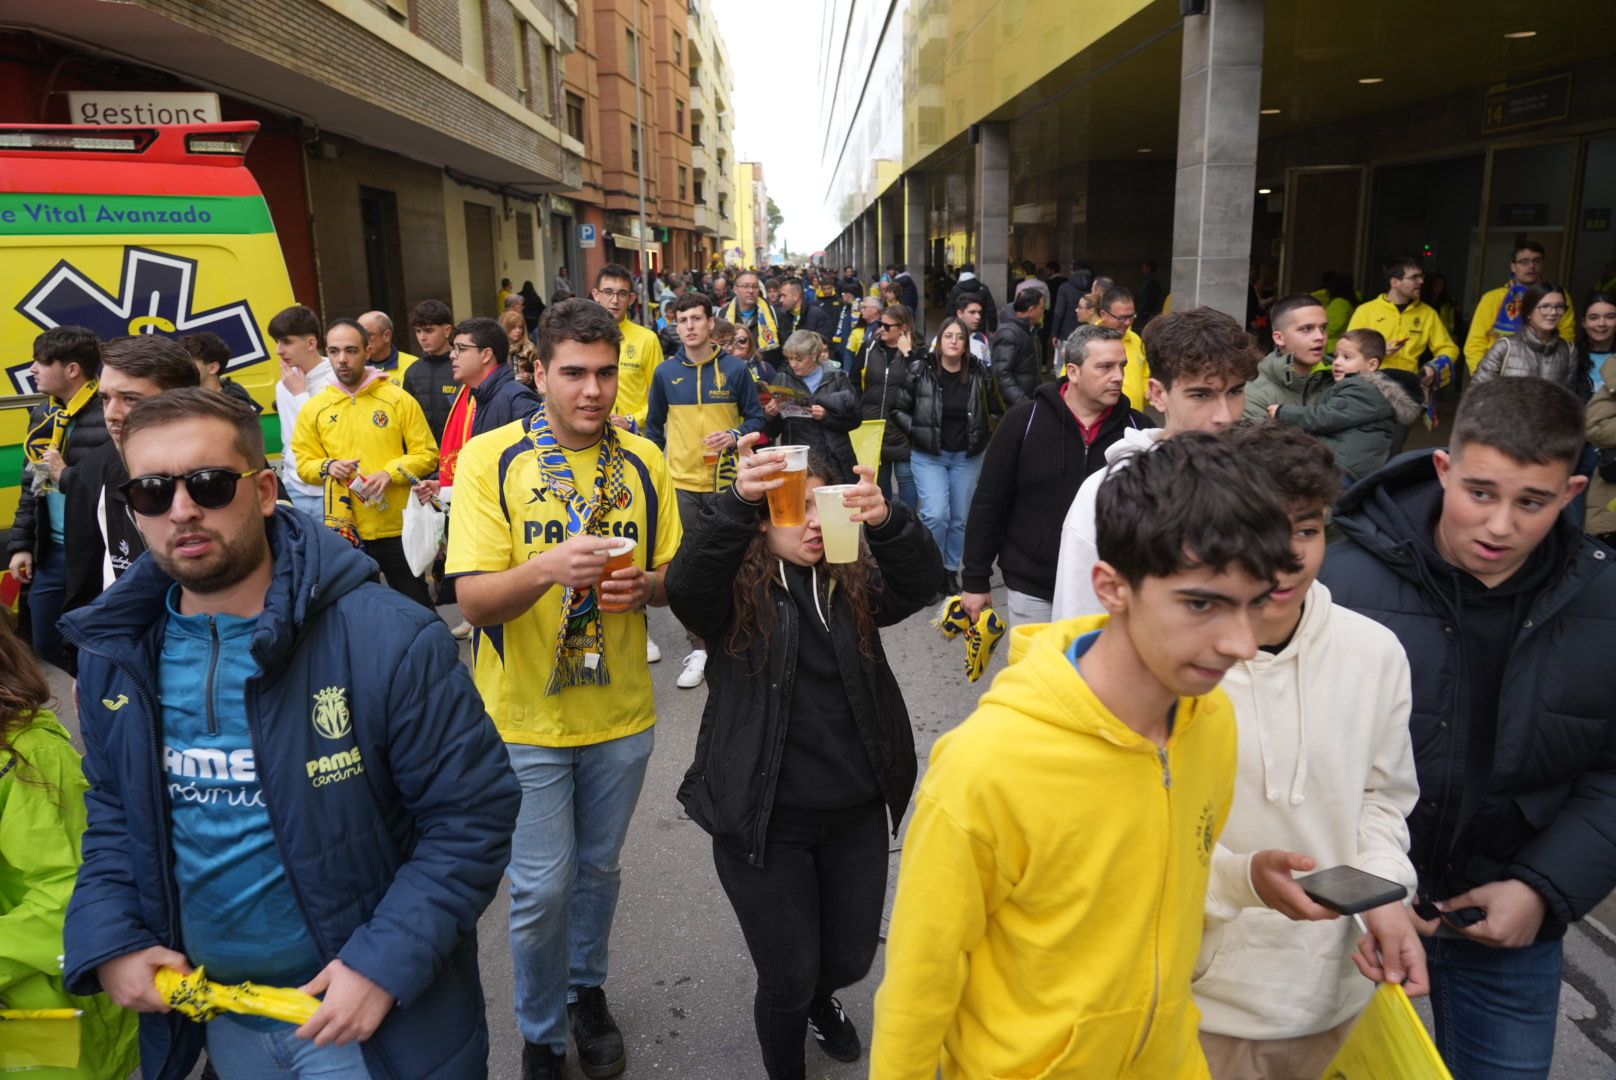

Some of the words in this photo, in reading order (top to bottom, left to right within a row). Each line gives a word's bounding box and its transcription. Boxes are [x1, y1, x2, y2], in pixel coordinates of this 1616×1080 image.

[80, 102, 207, 125] gestions
[23, 203, 86, 223] Vital
[95, 205, 212, 223] Avanzado
[582, 226, 592, 239] P
